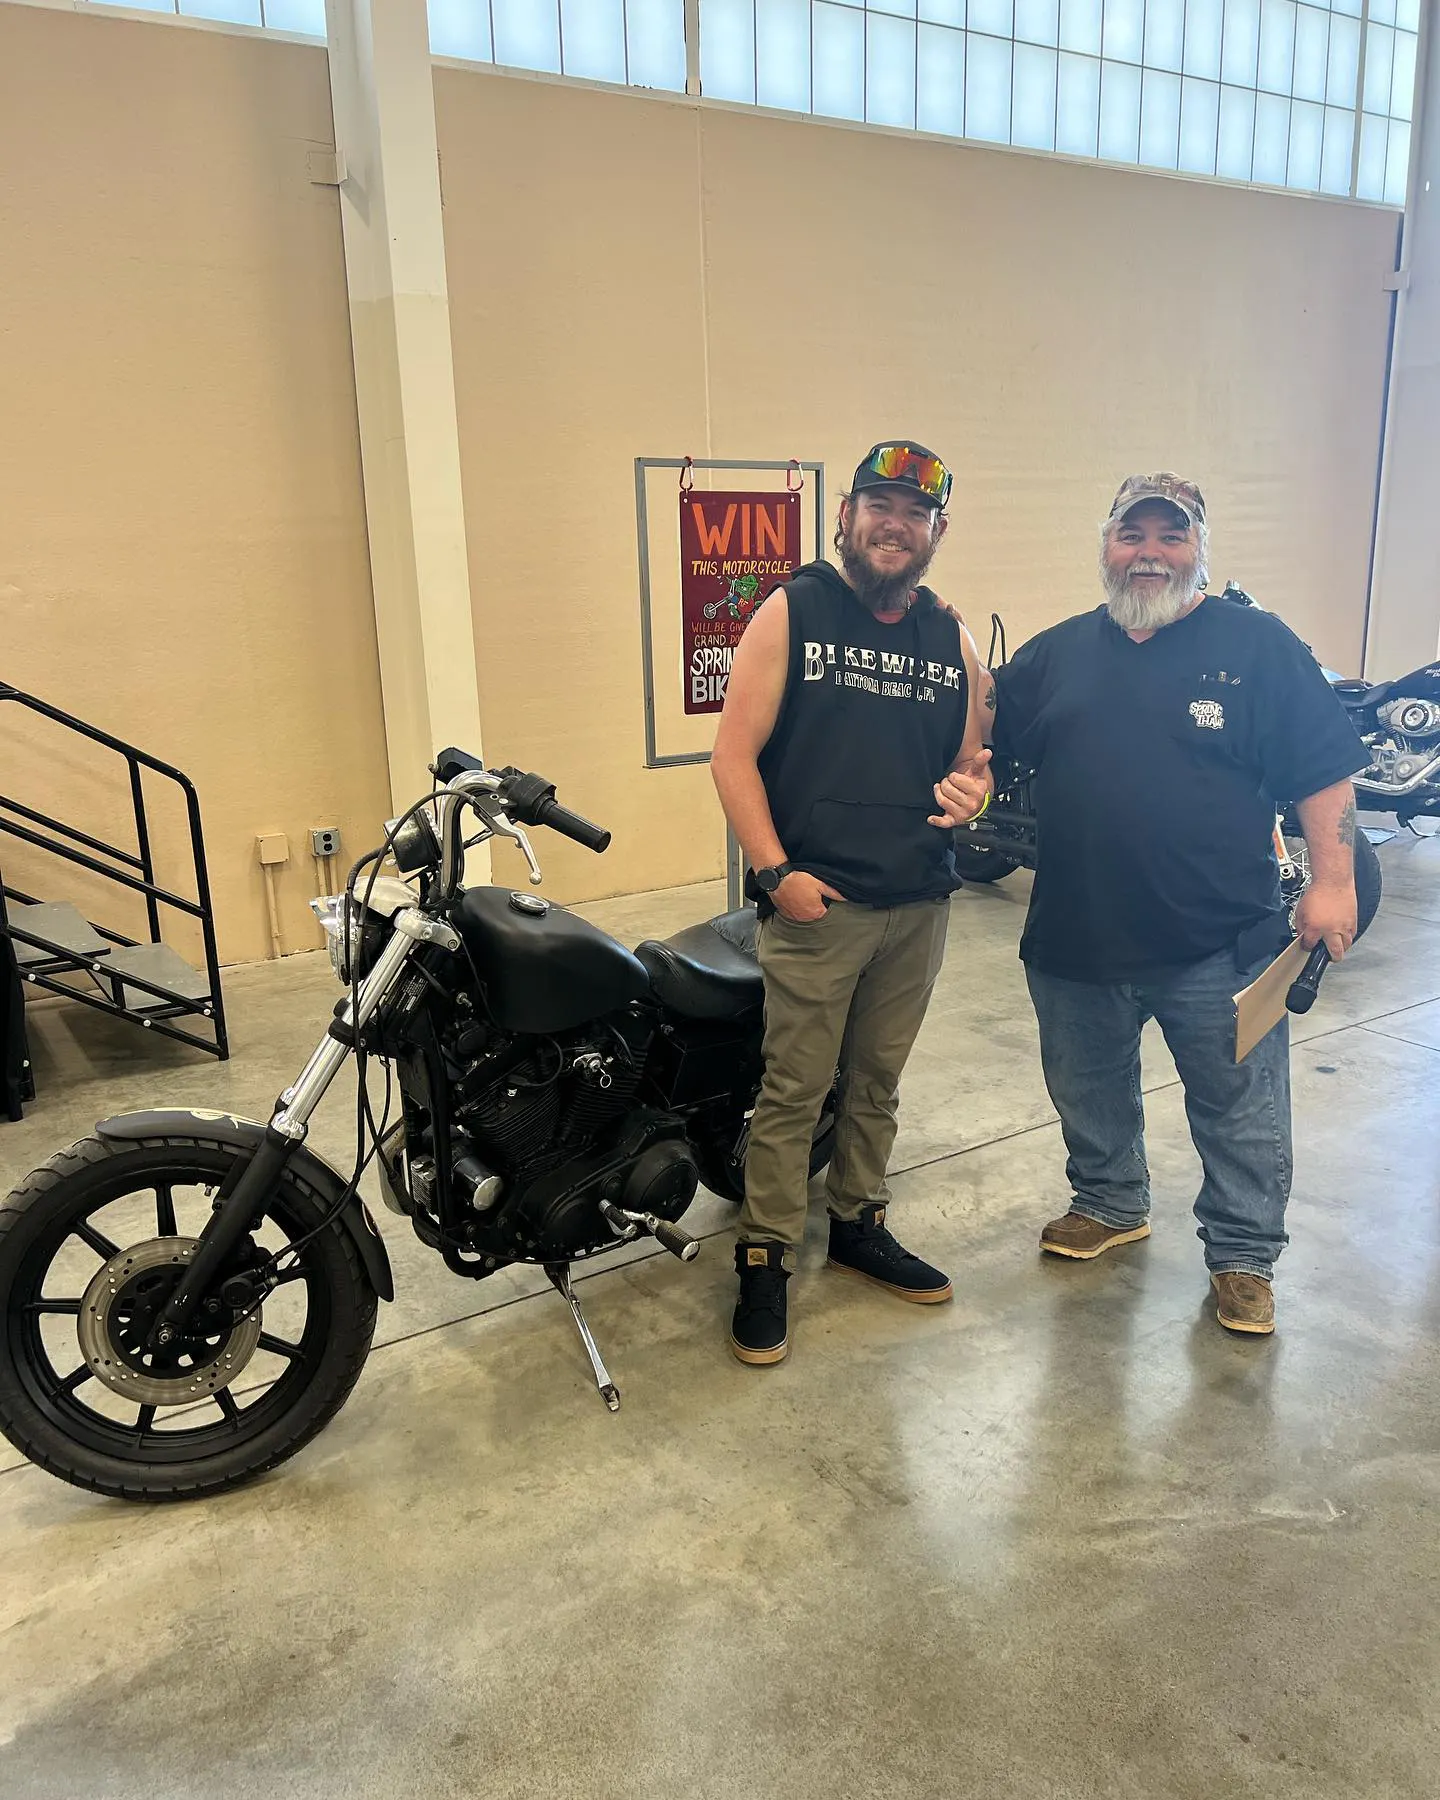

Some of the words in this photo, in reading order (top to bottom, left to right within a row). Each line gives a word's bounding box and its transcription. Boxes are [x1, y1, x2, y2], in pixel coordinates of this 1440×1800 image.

[692, 503, 786, 556] WIN
[691, 560, 718, 576] THIS
[722, 560, 792, 576] MOTORCYCLE
[691, 622, 713, 633] WILL
[714, 622, 726, 632] BE
[694, 634, 727, 648] GRAND
[690, 646, 736, 676] SPRIN
[692, 674, 728, 704] BIK
[1189, 701, 1223, 717] SPRING
